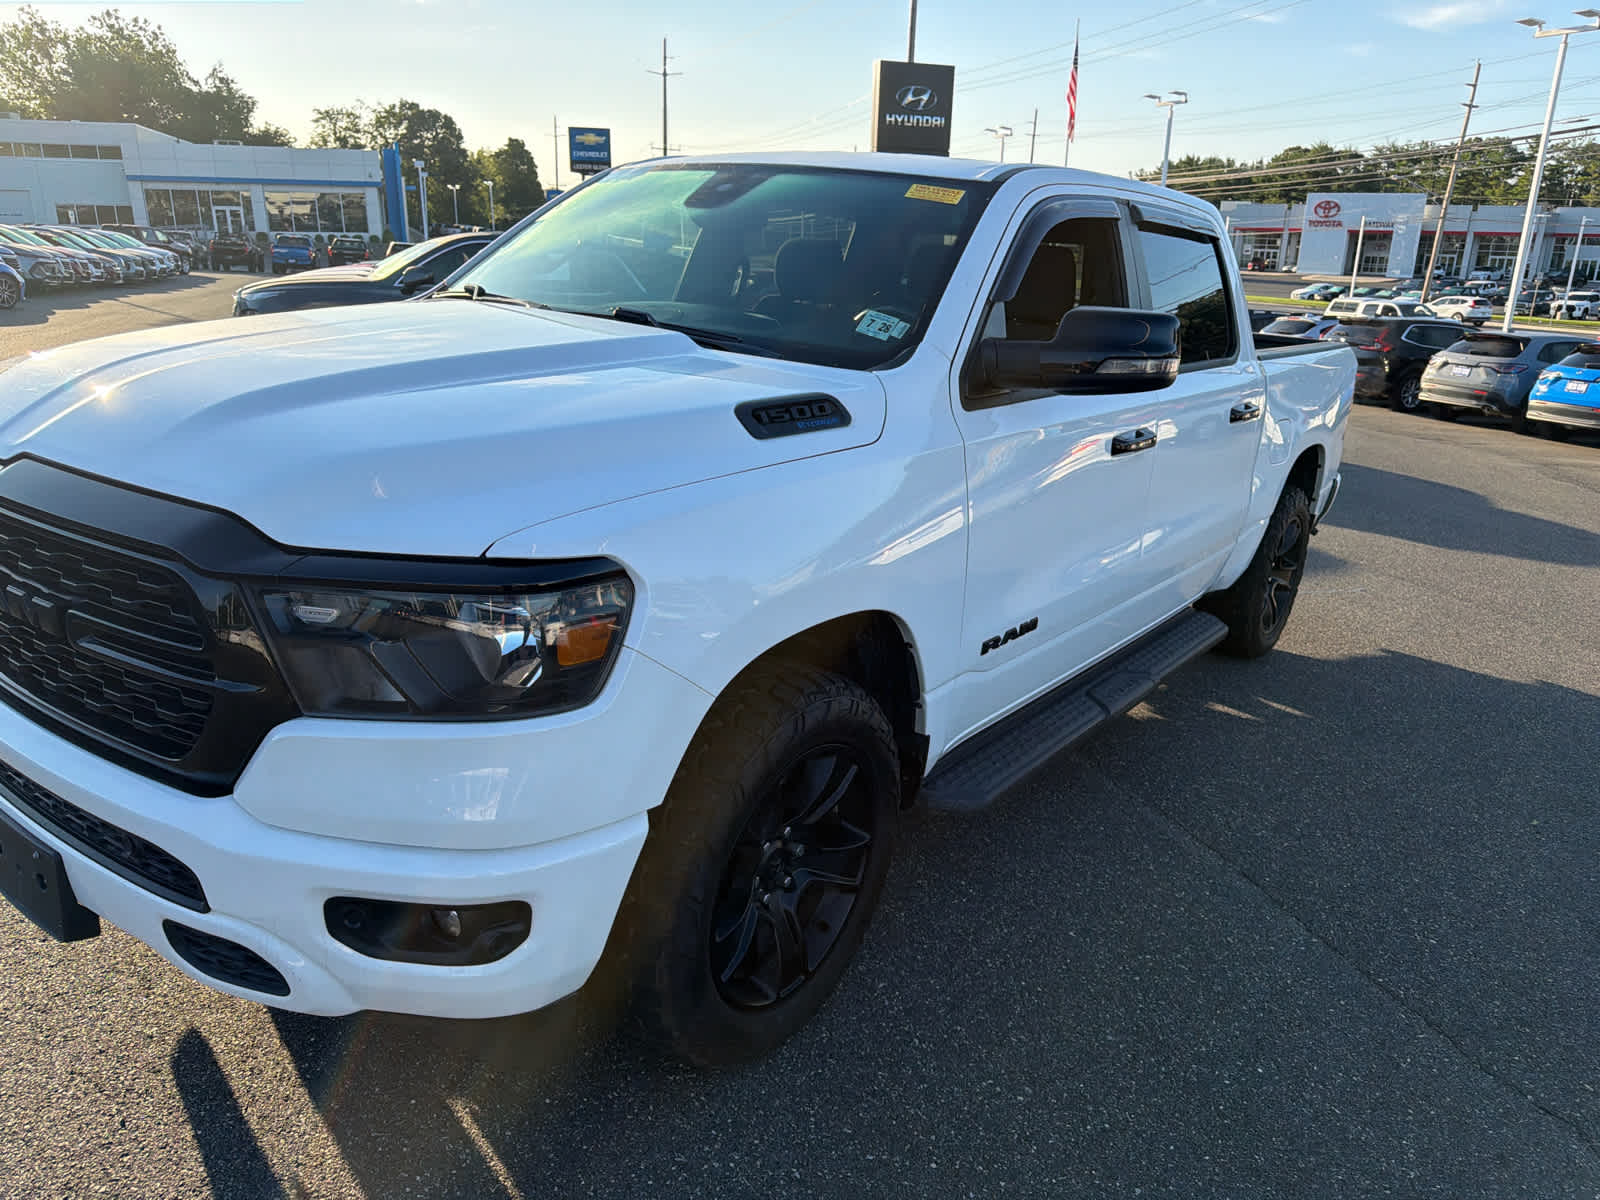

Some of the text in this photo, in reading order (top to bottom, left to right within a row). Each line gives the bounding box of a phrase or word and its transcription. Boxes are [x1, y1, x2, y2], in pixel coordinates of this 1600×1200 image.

[885, 113, 945, 128] HYUNDAI
[1308, 219, 1343, 228] TOYOTA
[865, 318, 876, 328] 7
[752, 401, 833, 425] 1500
[980, 616, 1039, 656] RAM
